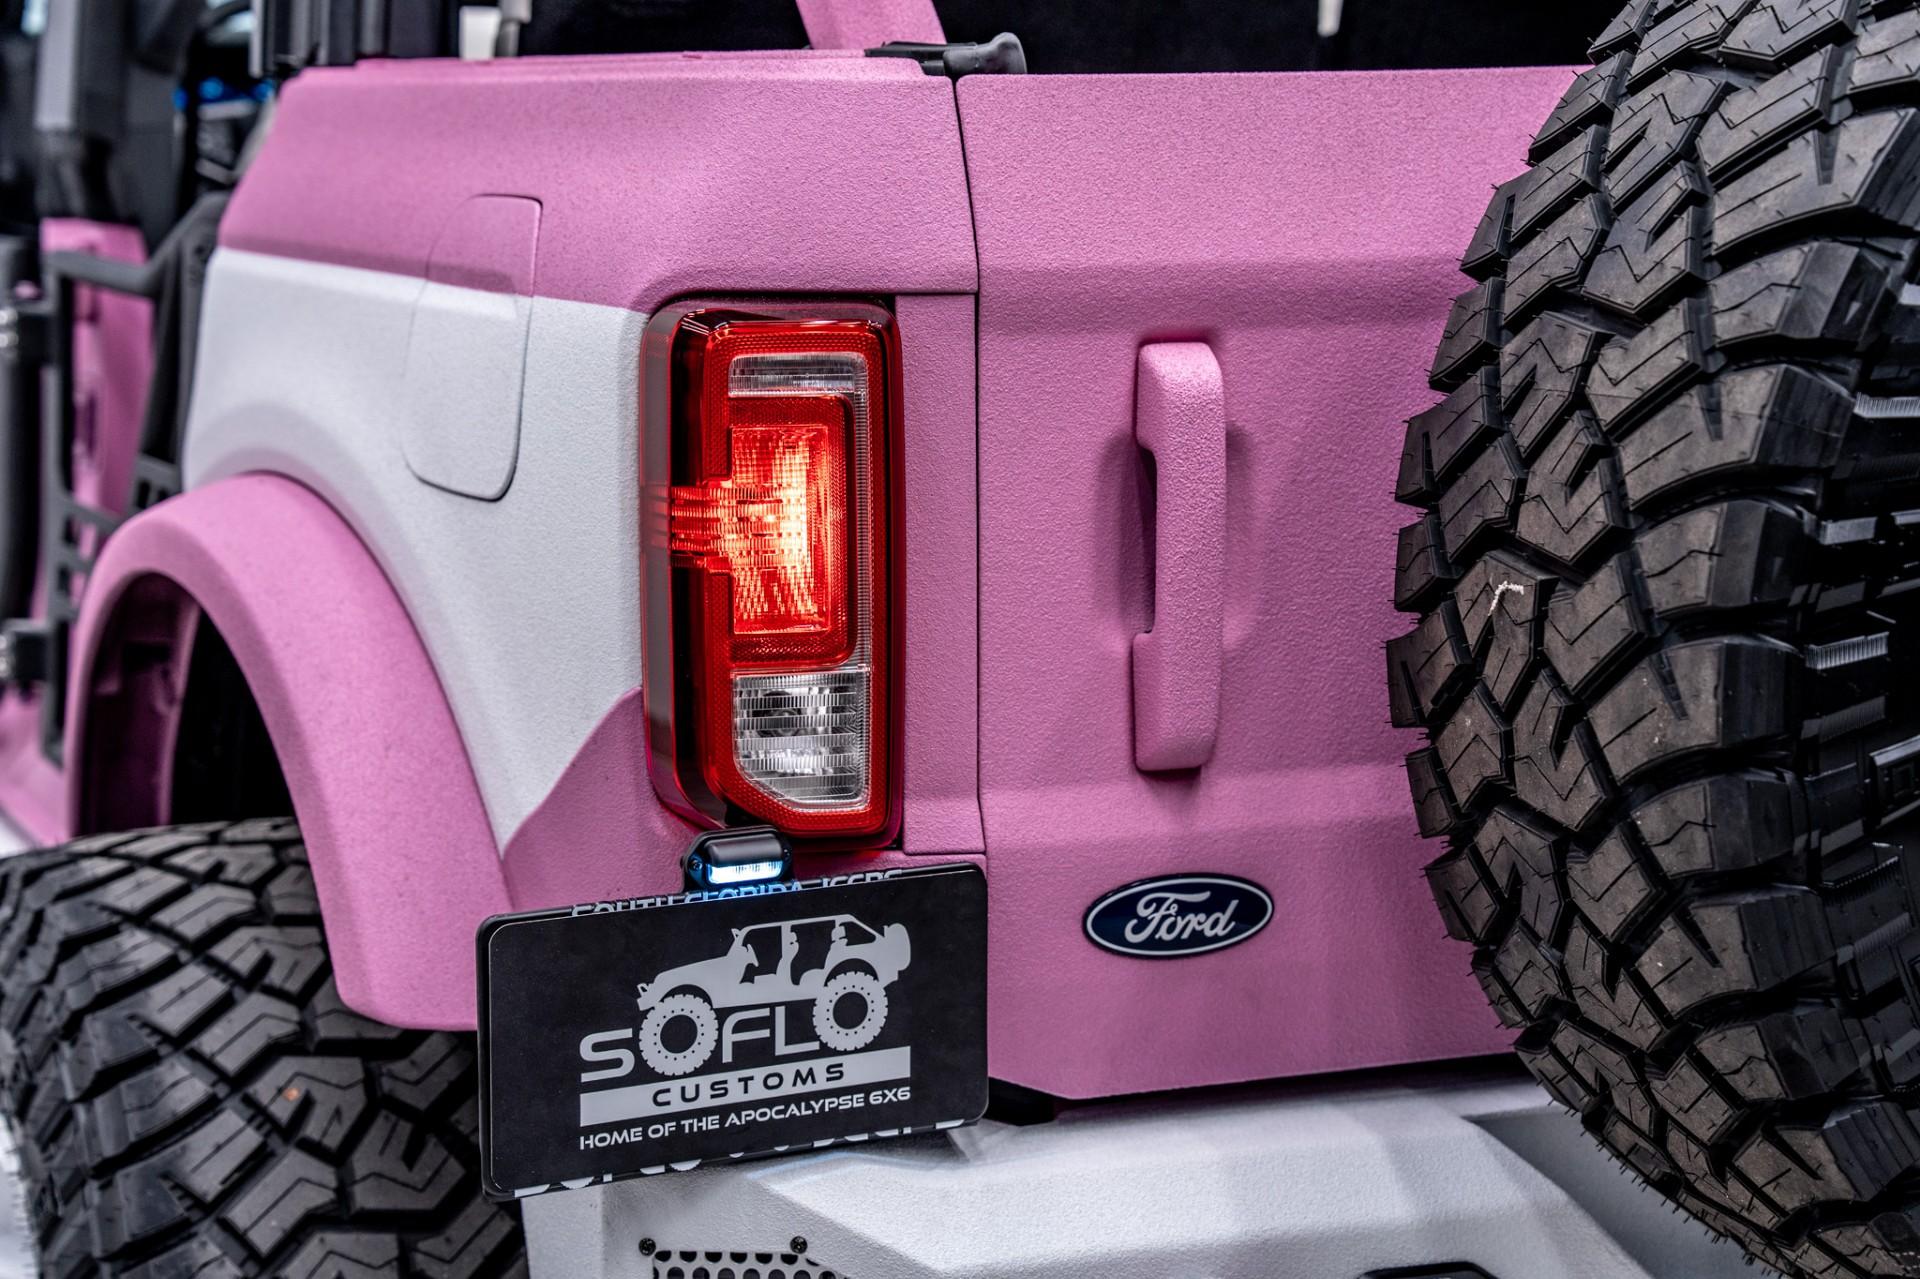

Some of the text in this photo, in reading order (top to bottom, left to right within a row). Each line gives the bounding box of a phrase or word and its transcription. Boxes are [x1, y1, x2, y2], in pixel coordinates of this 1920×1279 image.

[1124, 890, 1239, 943] Ford
[579, 971, 888, 1083] SOFLO
[652, 1063, 844, 1107] CUSTOMS
[579, 1086, 911, 1150] HOME OF THE APOCALYPSE 6X6
